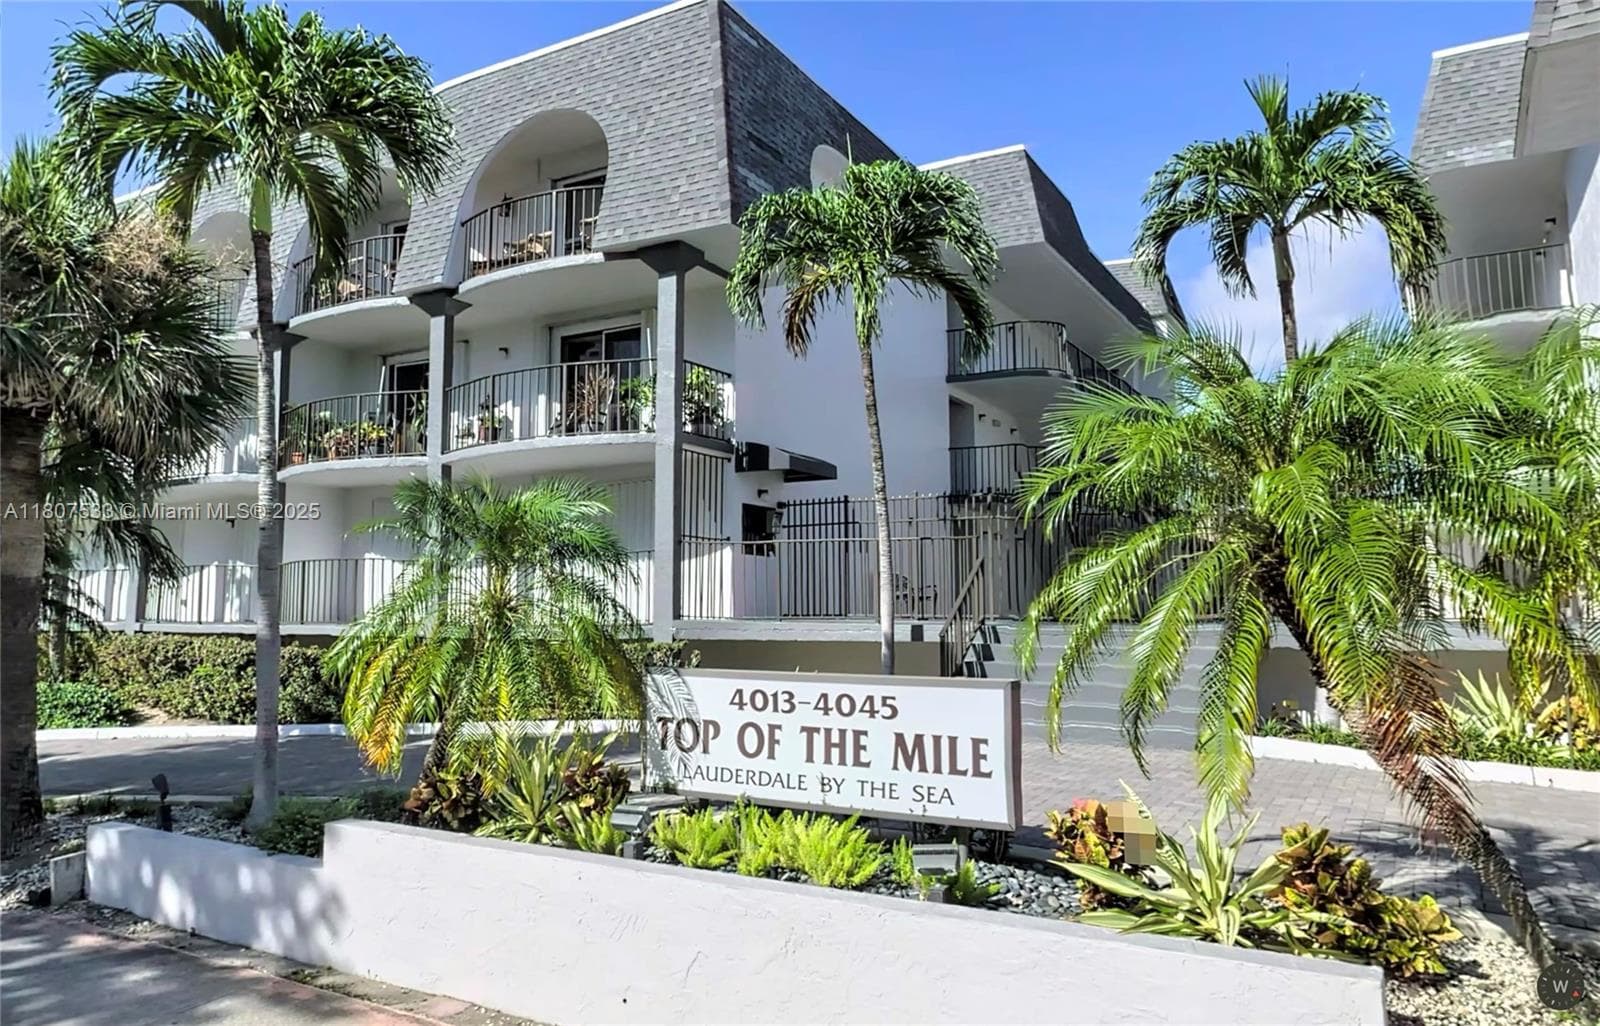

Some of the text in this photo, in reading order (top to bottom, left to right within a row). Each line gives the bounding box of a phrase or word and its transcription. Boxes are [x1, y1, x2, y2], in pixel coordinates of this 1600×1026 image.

[729, 688, 899, 720] 4013-4045
[656, 716, 993, 779] TOP OF THE MILE
[683, 763, 955, 806] LAUDERDALE BY THE SEA
